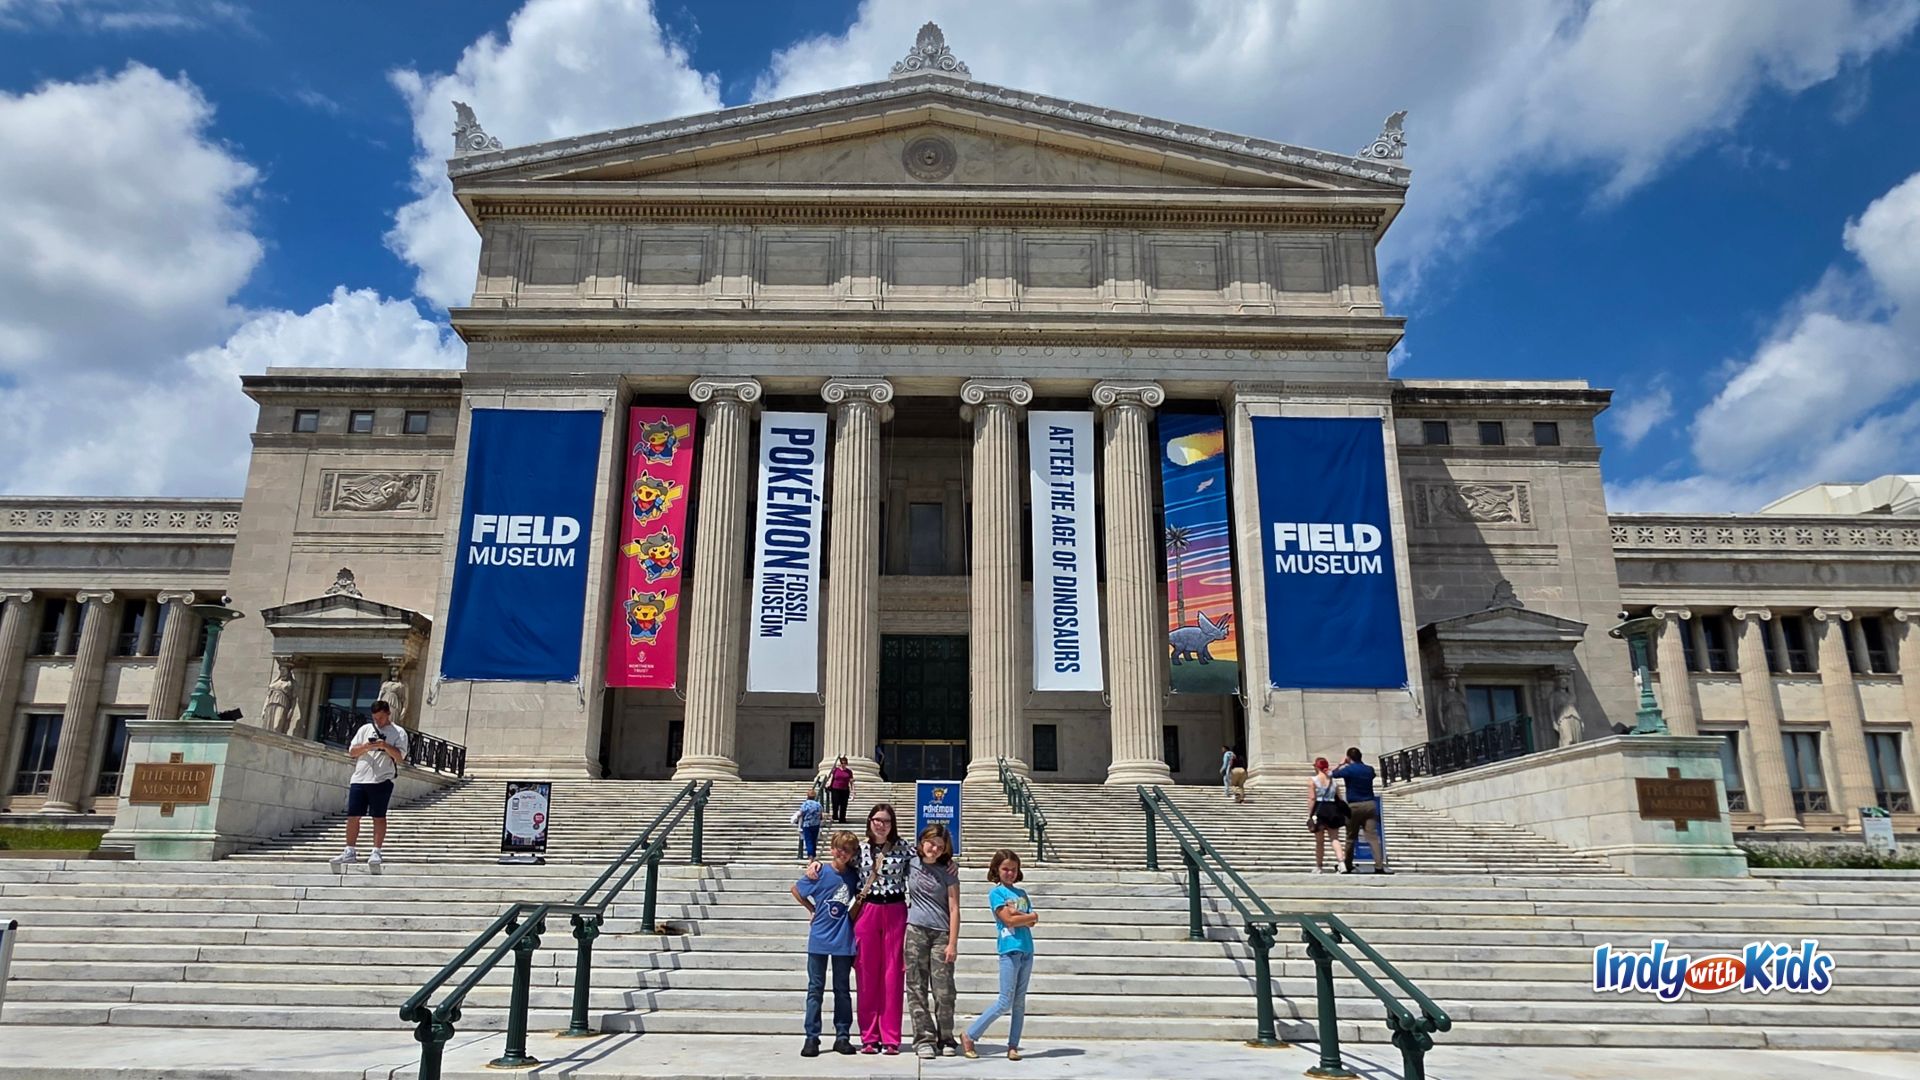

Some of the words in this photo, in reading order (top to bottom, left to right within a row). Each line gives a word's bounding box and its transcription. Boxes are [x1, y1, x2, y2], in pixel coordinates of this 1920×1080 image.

[1049, 425, 1074, 479] AFTER
[764, 427, 821, 570] POKÉMON
[1051, 481, 1075, 512] THE
[471, 514, 580, 545] FIELD
[1051, 514, 1076, 547] AGE
[1273, 522, 1382, 552] FIELD
[468, 546, 575, 567] MUSEUM
[1052, 550, 1077, 572] OF
[1275, 554, 1382, 574] MUSEUM
[760, 572, 785, 638] MUSEUM
[784, 573, 809, 625] FOSSIL
[1053, 576, 1081, 674] DINOSAURS
[141, 770, 166, 781] THE
[170, 770, 206, 782] FIELD
[142, 783, 198, 795] MUSEUM
[1643, 784, 1672, 796] THE
[1674, 784, 1710, 797] FIELD
